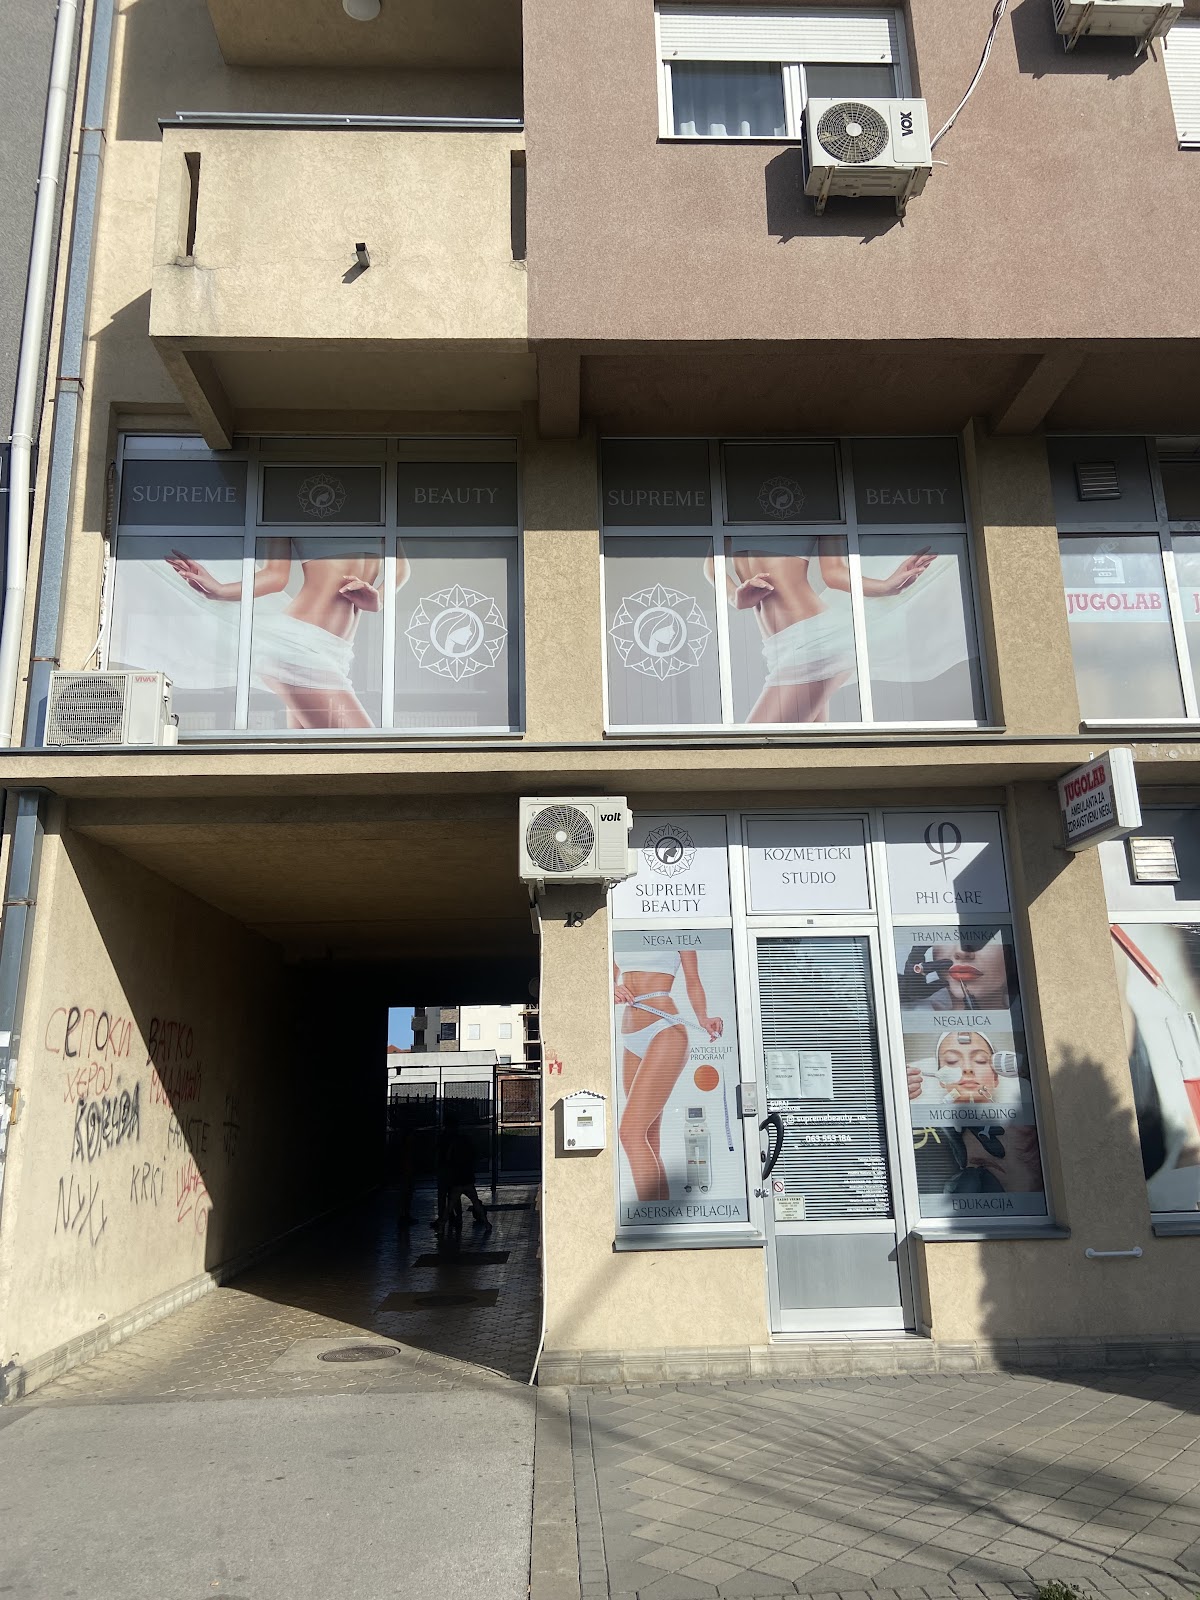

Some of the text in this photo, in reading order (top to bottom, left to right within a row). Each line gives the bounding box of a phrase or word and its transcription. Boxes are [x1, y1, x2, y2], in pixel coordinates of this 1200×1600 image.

[900, 111, 913, 137] VOX
[132, 485, 238, 504] SUPREME
[413, 486, 499, 505] BEAUTY
[607, 489, 706, 508] SUPREME
[866, 488, 948, 506] BEAUTY
[1066, 592, 1162, 614] JUGOLAB
[134, 675, 157, 683] VIVAX
[1063, 765, 1106, 807] JUGOLAB
[1070, 790, 1106, 818] AMBULANTA ZA
[600, 812, 621, 822] volt
[1067, 802, 1112, 833] ZDRAVSTVENU NEGU
[781, 871, 836, 885] STUDIO
[635, 883, 706, 897] SUPREME
[916, 890, 983, 905] PHI CARE
[641, 899, 701, 913] BEAUTY
[564, 911, 584, 928] 18
[642, 934, 702, 947] NEGA TELA
[912, 928, 996, 943] TRAJNA ŠMINKA
[933, 1015, 992, 1027] NEGA LICA
[690, 1046, 733, 1054] ANTICELULIT
[690, 1053, 726, 1061] PROGRAM
[929, 1107, 1017, 1121] MICROBLADING
[627, 1204, 741, 1220] LASERSKA EPILACIJA
[951, 1197, 1015, 1213] EDUKACIJA
